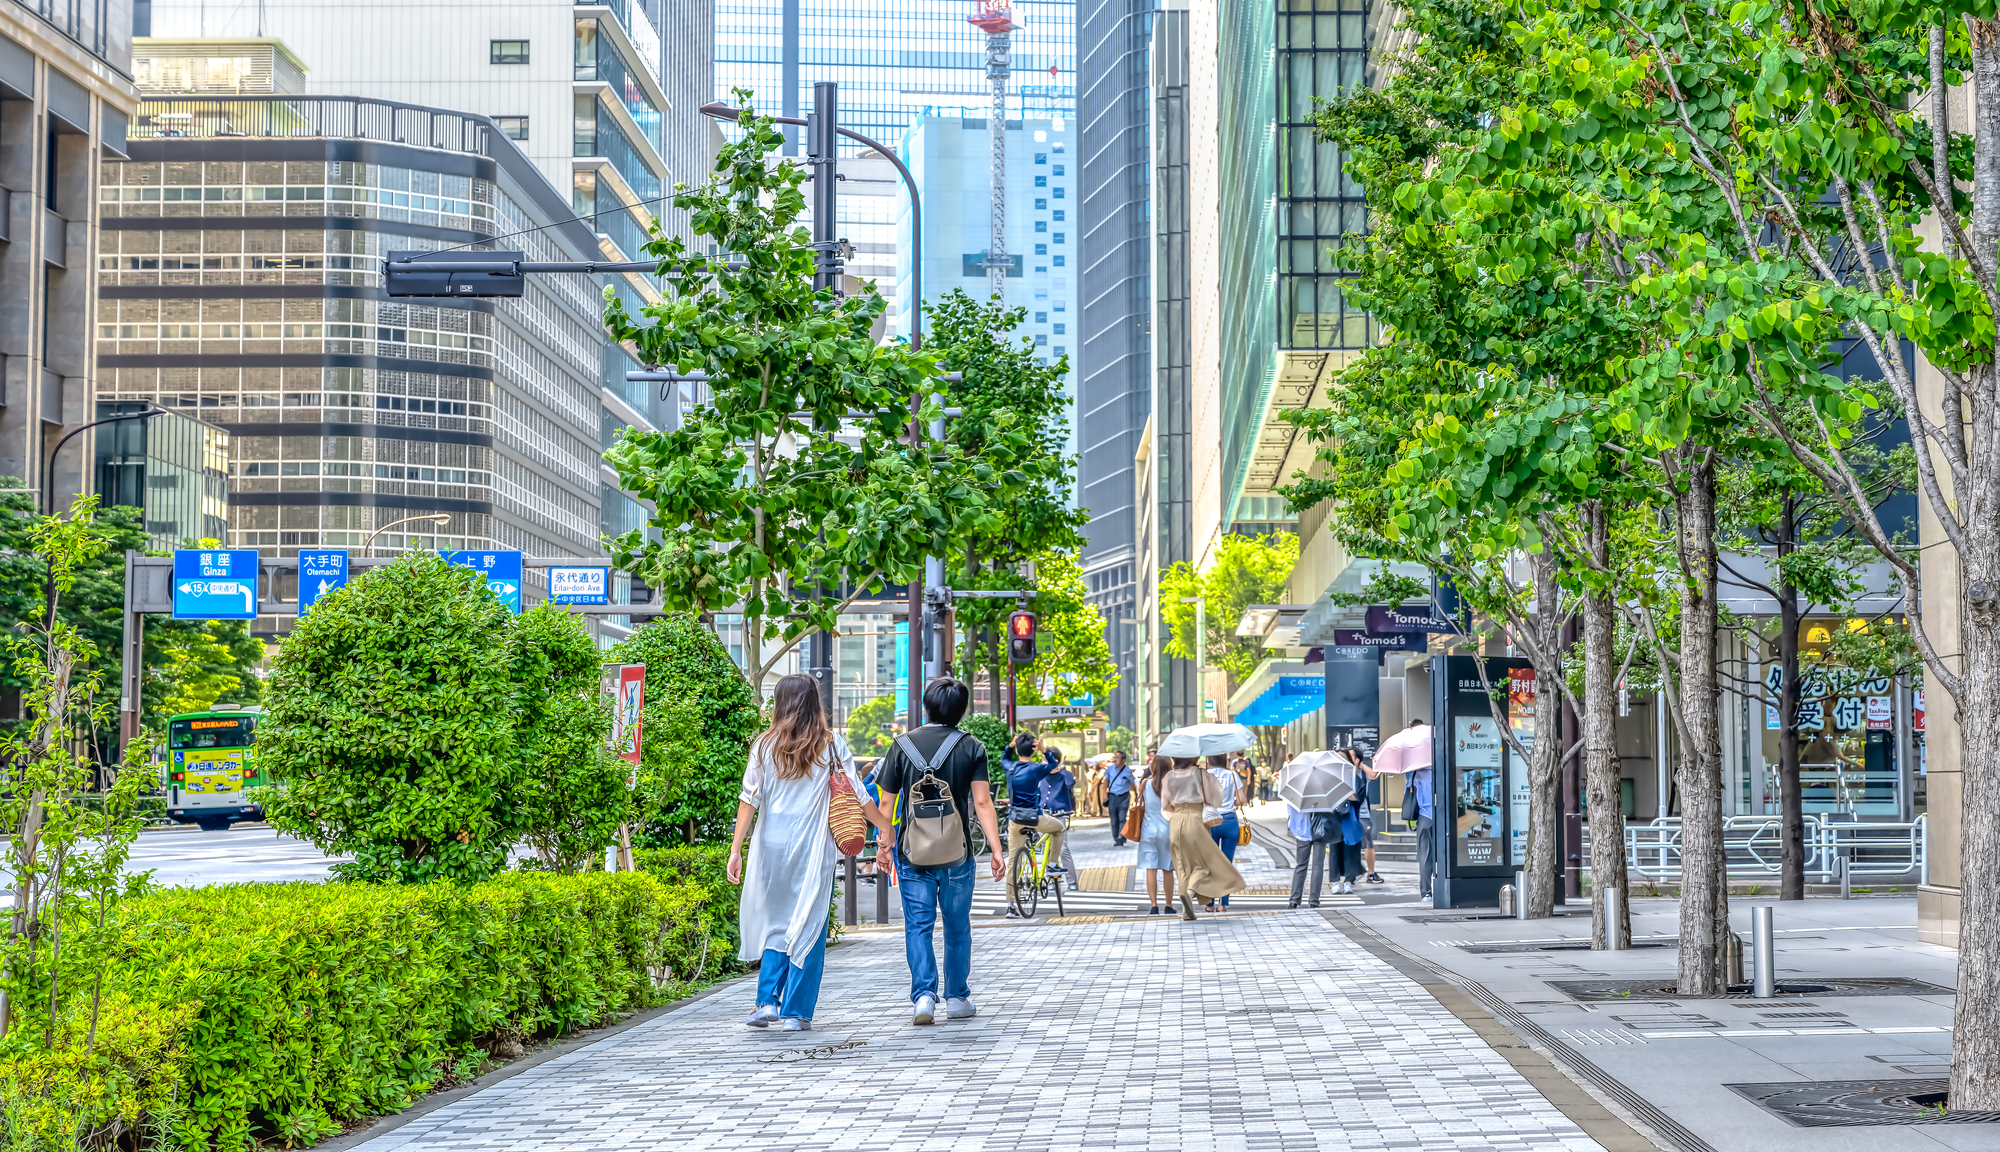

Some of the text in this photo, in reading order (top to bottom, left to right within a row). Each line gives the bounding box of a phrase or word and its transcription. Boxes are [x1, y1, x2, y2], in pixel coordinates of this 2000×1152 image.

[200, 553, 230, 566] 銀座
[303, 555, 343, 568] 大手町
[464, 555, 496, 568] 上野
[203, 566, 227, 576] Ginza
[307, 568, 340, 576] Otemachi
[555, 572, 600, 583] 永代通り
[193, 583, 202, 593] 15
[211, 584, 235, 593] 中央通り
[494, 584, 500, 593] 4
[554, 583, 585, 591] Eitai-dori
[1360, 635, 1406, 646] Tomod's
[1290, 679, 1325, 687] CORED
[1798, 699, 1864, 728] 受付
